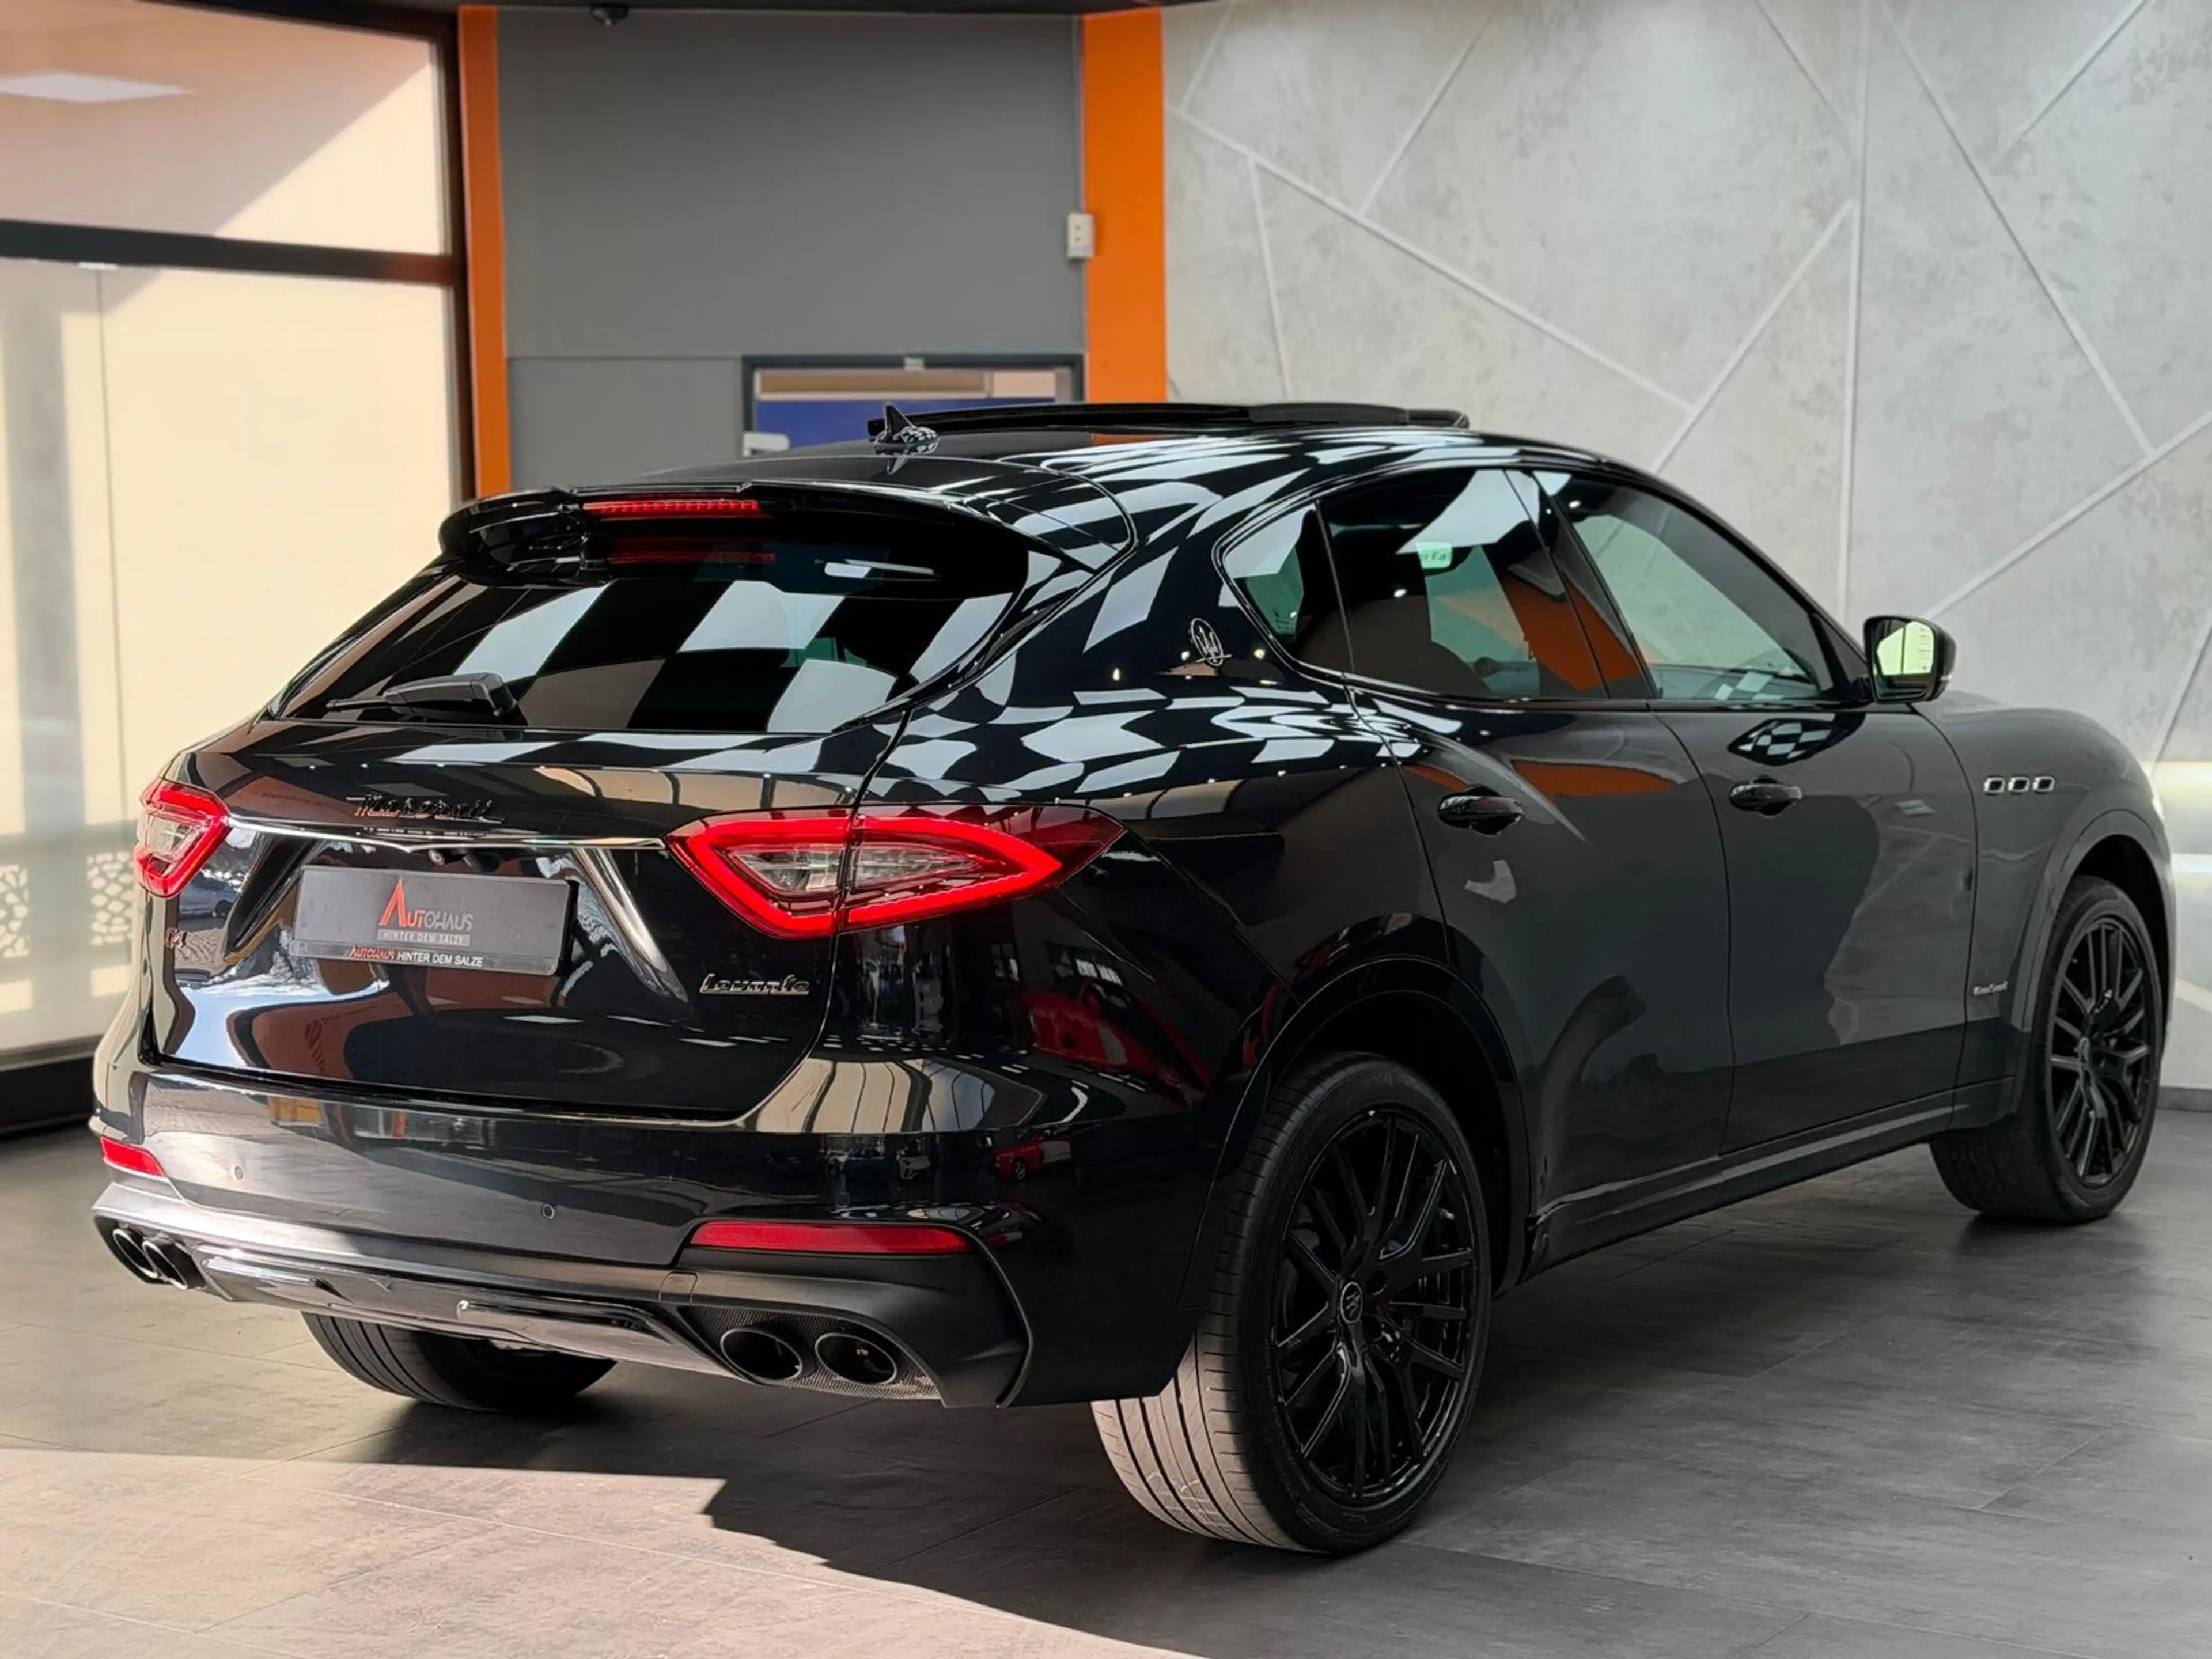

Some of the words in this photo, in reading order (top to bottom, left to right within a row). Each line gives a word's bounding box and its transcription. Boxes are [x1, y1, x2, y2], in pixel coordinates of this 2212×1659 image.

[350, 945, 395, 961] AUTOHAUS
[397, 950, 431, 963] HINTER
[432, 953, 452, 965] DEM
[454, 955, 484, 967] SALZE
[699, 973, 810, 995] Levante
